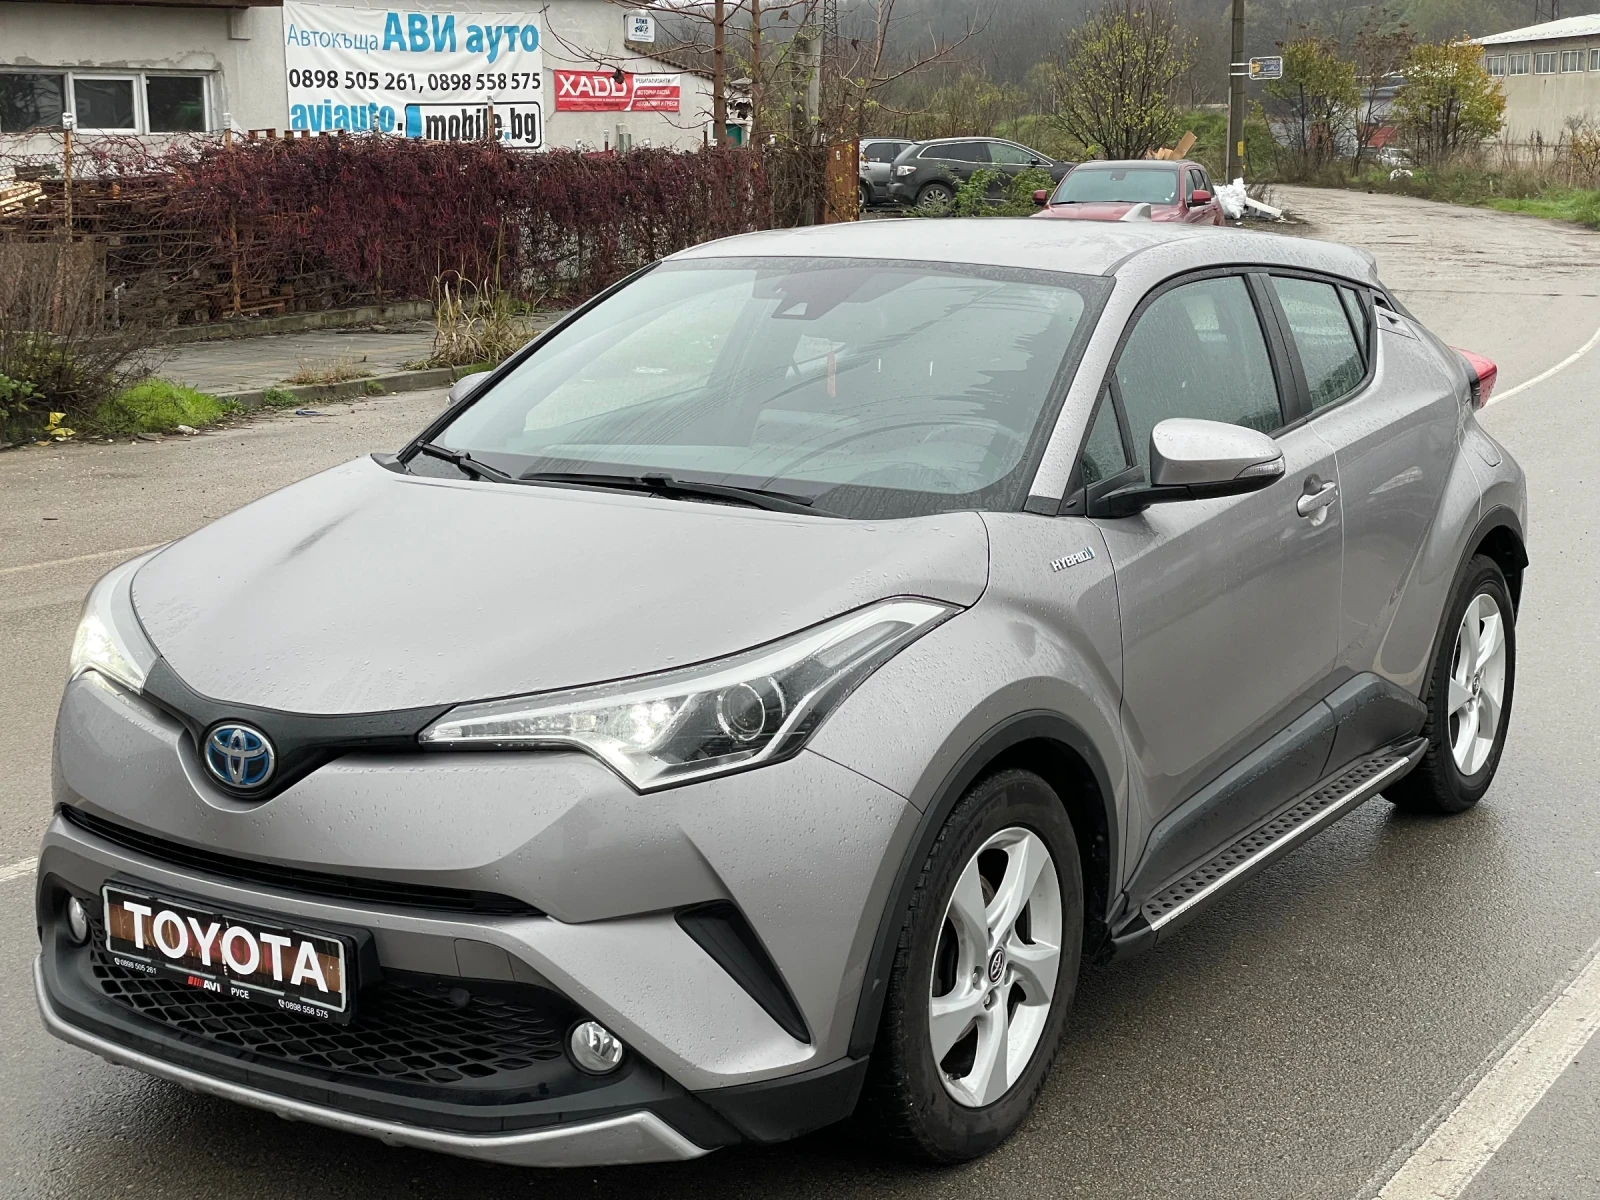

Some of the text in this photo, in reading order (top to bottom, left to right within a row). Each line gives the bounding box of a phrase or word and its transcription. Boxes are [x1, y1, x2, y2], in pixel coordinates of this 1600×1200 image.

[287, 12, 540, 64] Автокъща АВИ ауто
[289, 69, 541, 94] 0898 505 261, 0898 558 575
[1050, 550, 1092, 572] HYBRID
[123, 901, 329, 993] TOYOTA
[120, 959, 157, 974] 0898 505 261
[285, 1001, 329, 1019] 0898 558 575
